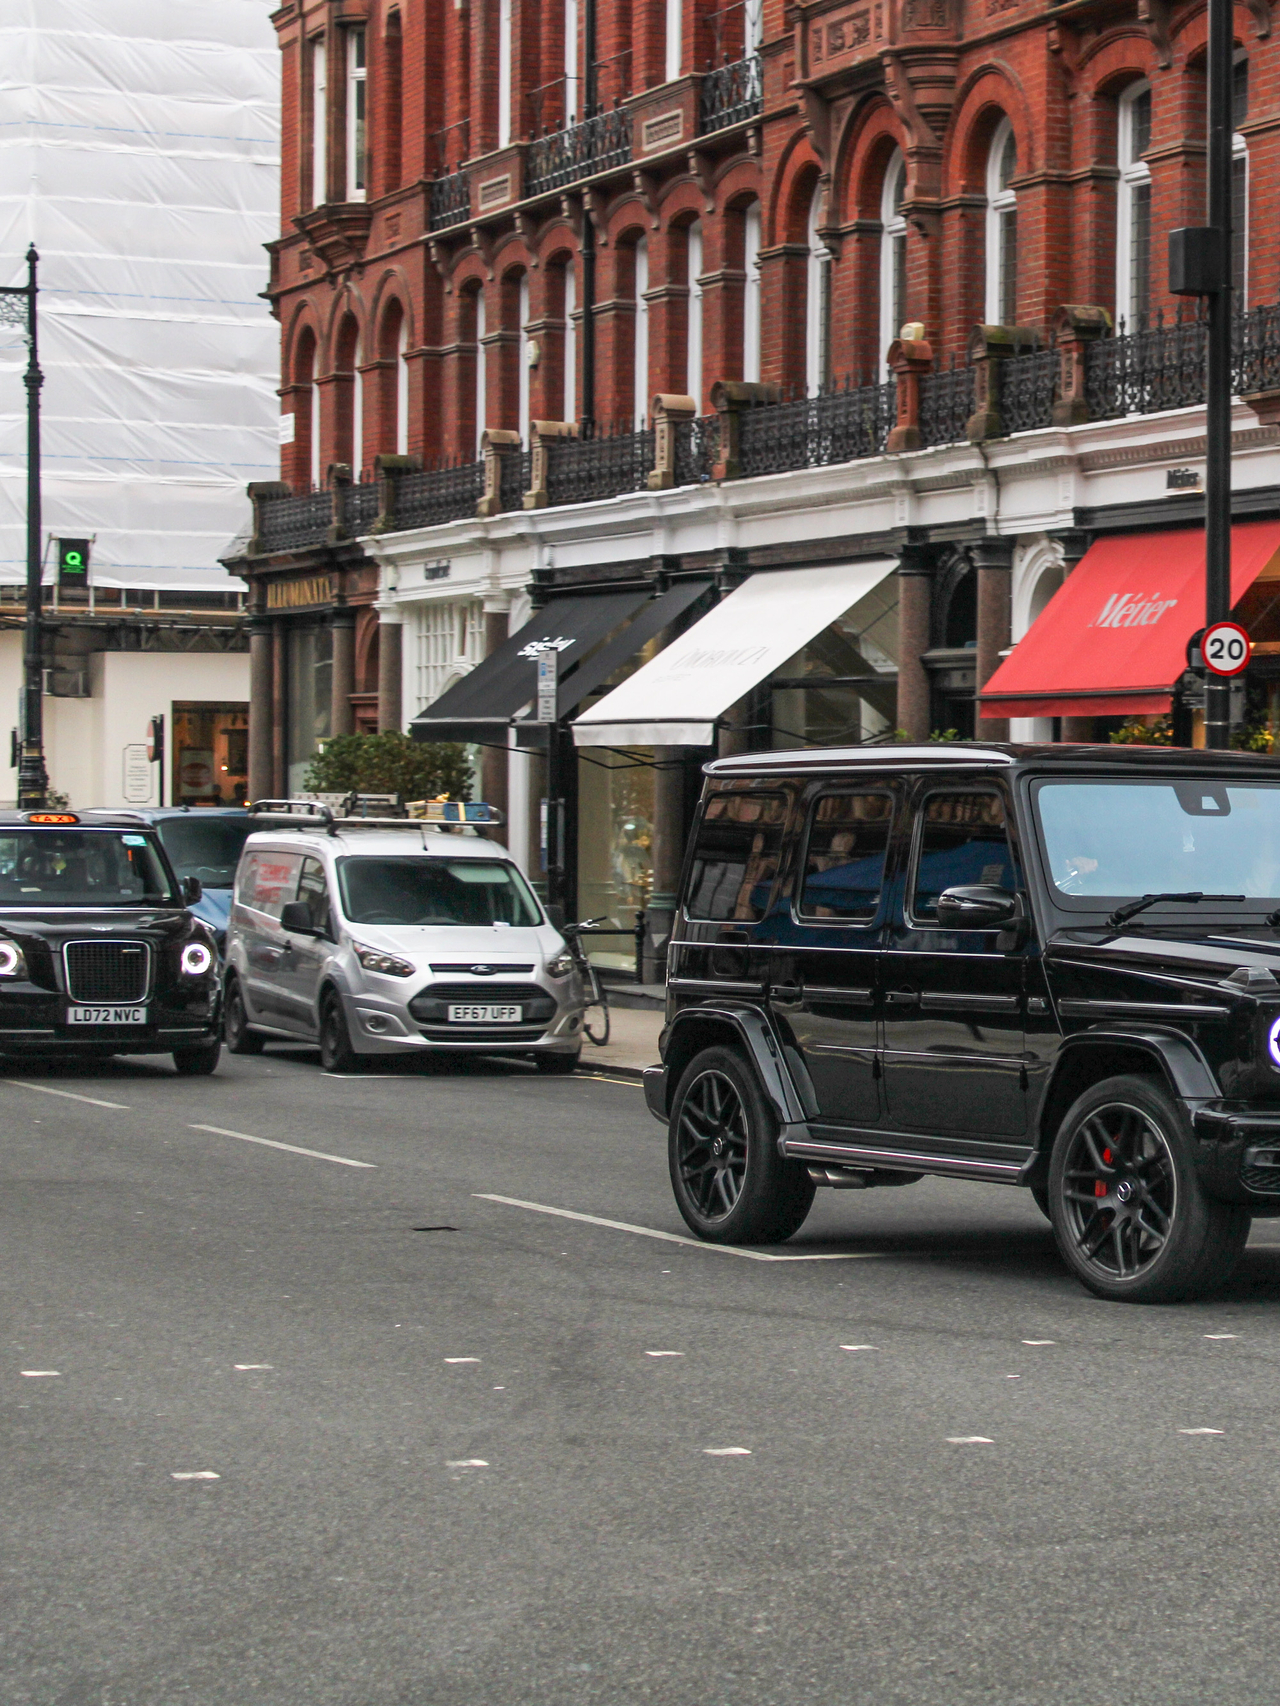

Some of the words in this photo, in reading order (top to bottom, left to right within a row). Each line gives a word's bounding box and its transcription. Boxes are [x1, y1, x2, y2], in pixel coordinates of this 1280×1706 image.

[65, 551, 82, 566] Q
[1087, 592, 1178, 628] Métier
[1210, 638, 1244, 660] 20
[74, 1009, 110, 1022] LD72
[114, 1009, 140, 1022] NVC
[454, 1007, 487, 1019] EF67
[491, 1007, 517, 1019] UFP
